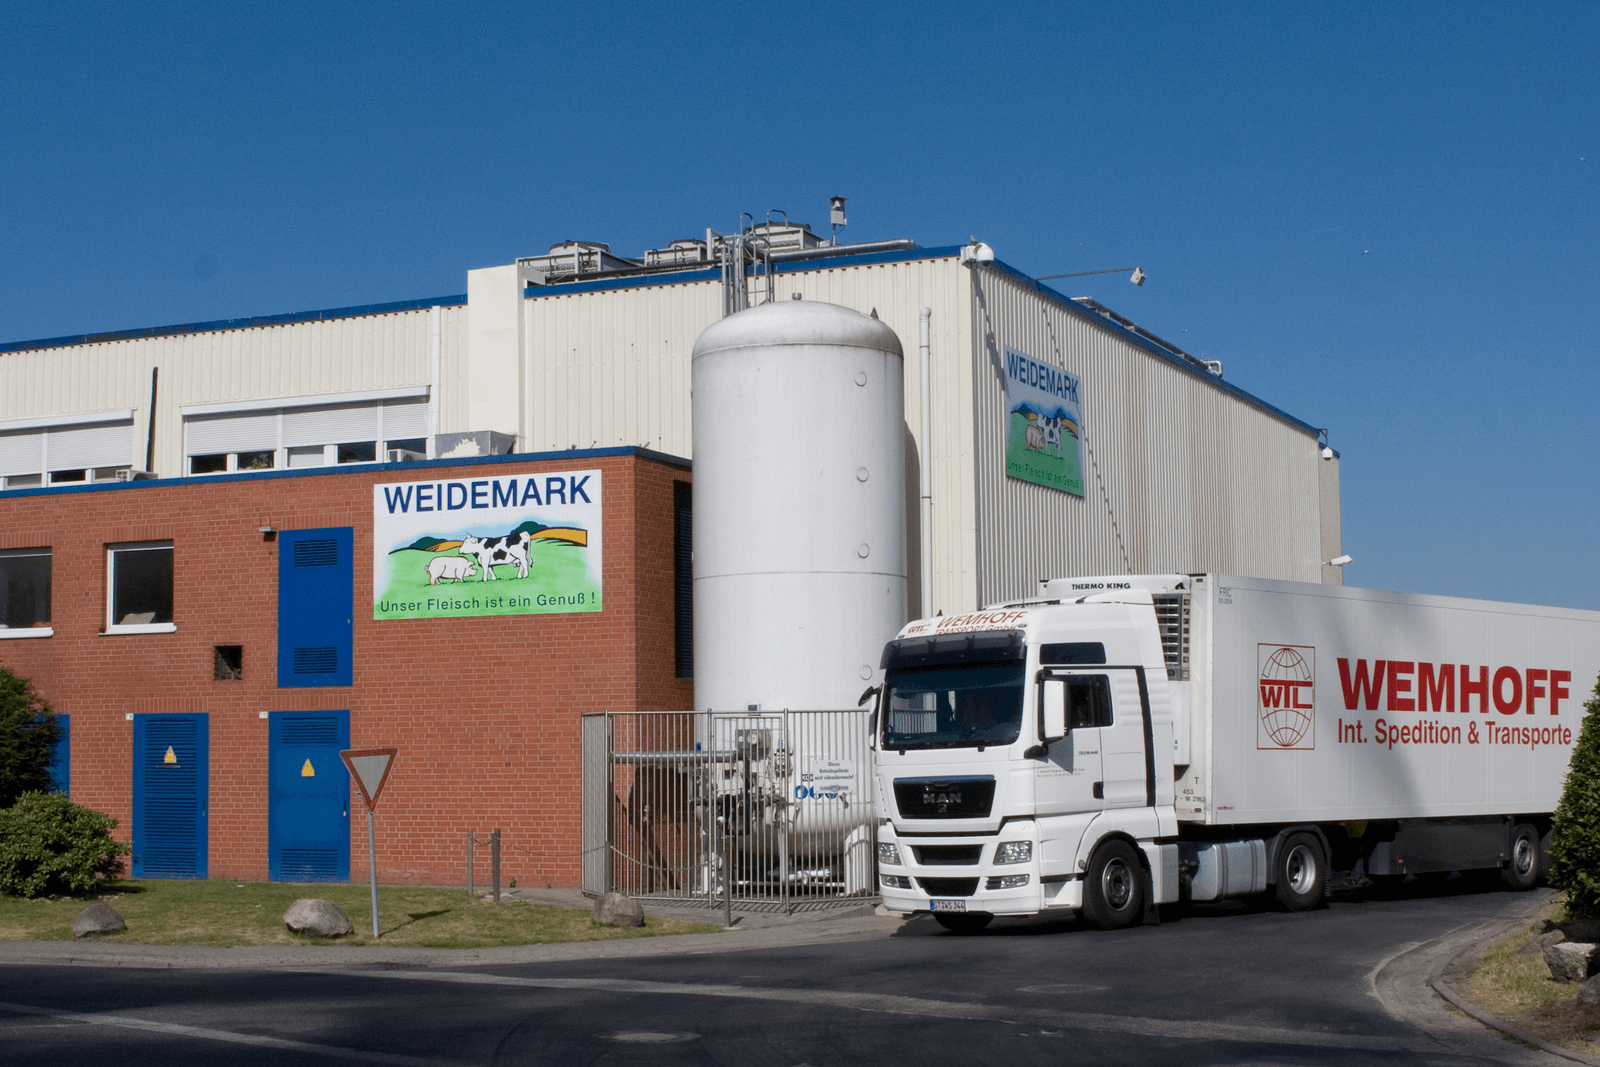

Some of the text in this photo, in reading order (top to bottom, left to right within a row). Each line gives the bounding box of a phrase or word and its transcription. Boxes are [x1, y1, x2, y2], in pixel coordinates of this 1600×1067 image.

[1007, 351, 1079, 404] WEIDEMARK
[384, 475, 592, 514] WEIDEMARK
[381, 600, 421, 613] Unser
[427, 597, 480, 610] Fleisch
[485, 596, 503, 608] ist
[509, 595, 531, 607] ein
[537, 592, 585, 606] Genuß
[935, 625, 984, 635] TRANSPORT
[937, 611, 1028, 628] WEMHOFF
[1336, 658, 1572, 716] WEMHOFF
[1338, 718, 1572, 750] Int. Spedition & Transporte
[923, 793, 962, 804] MAN
